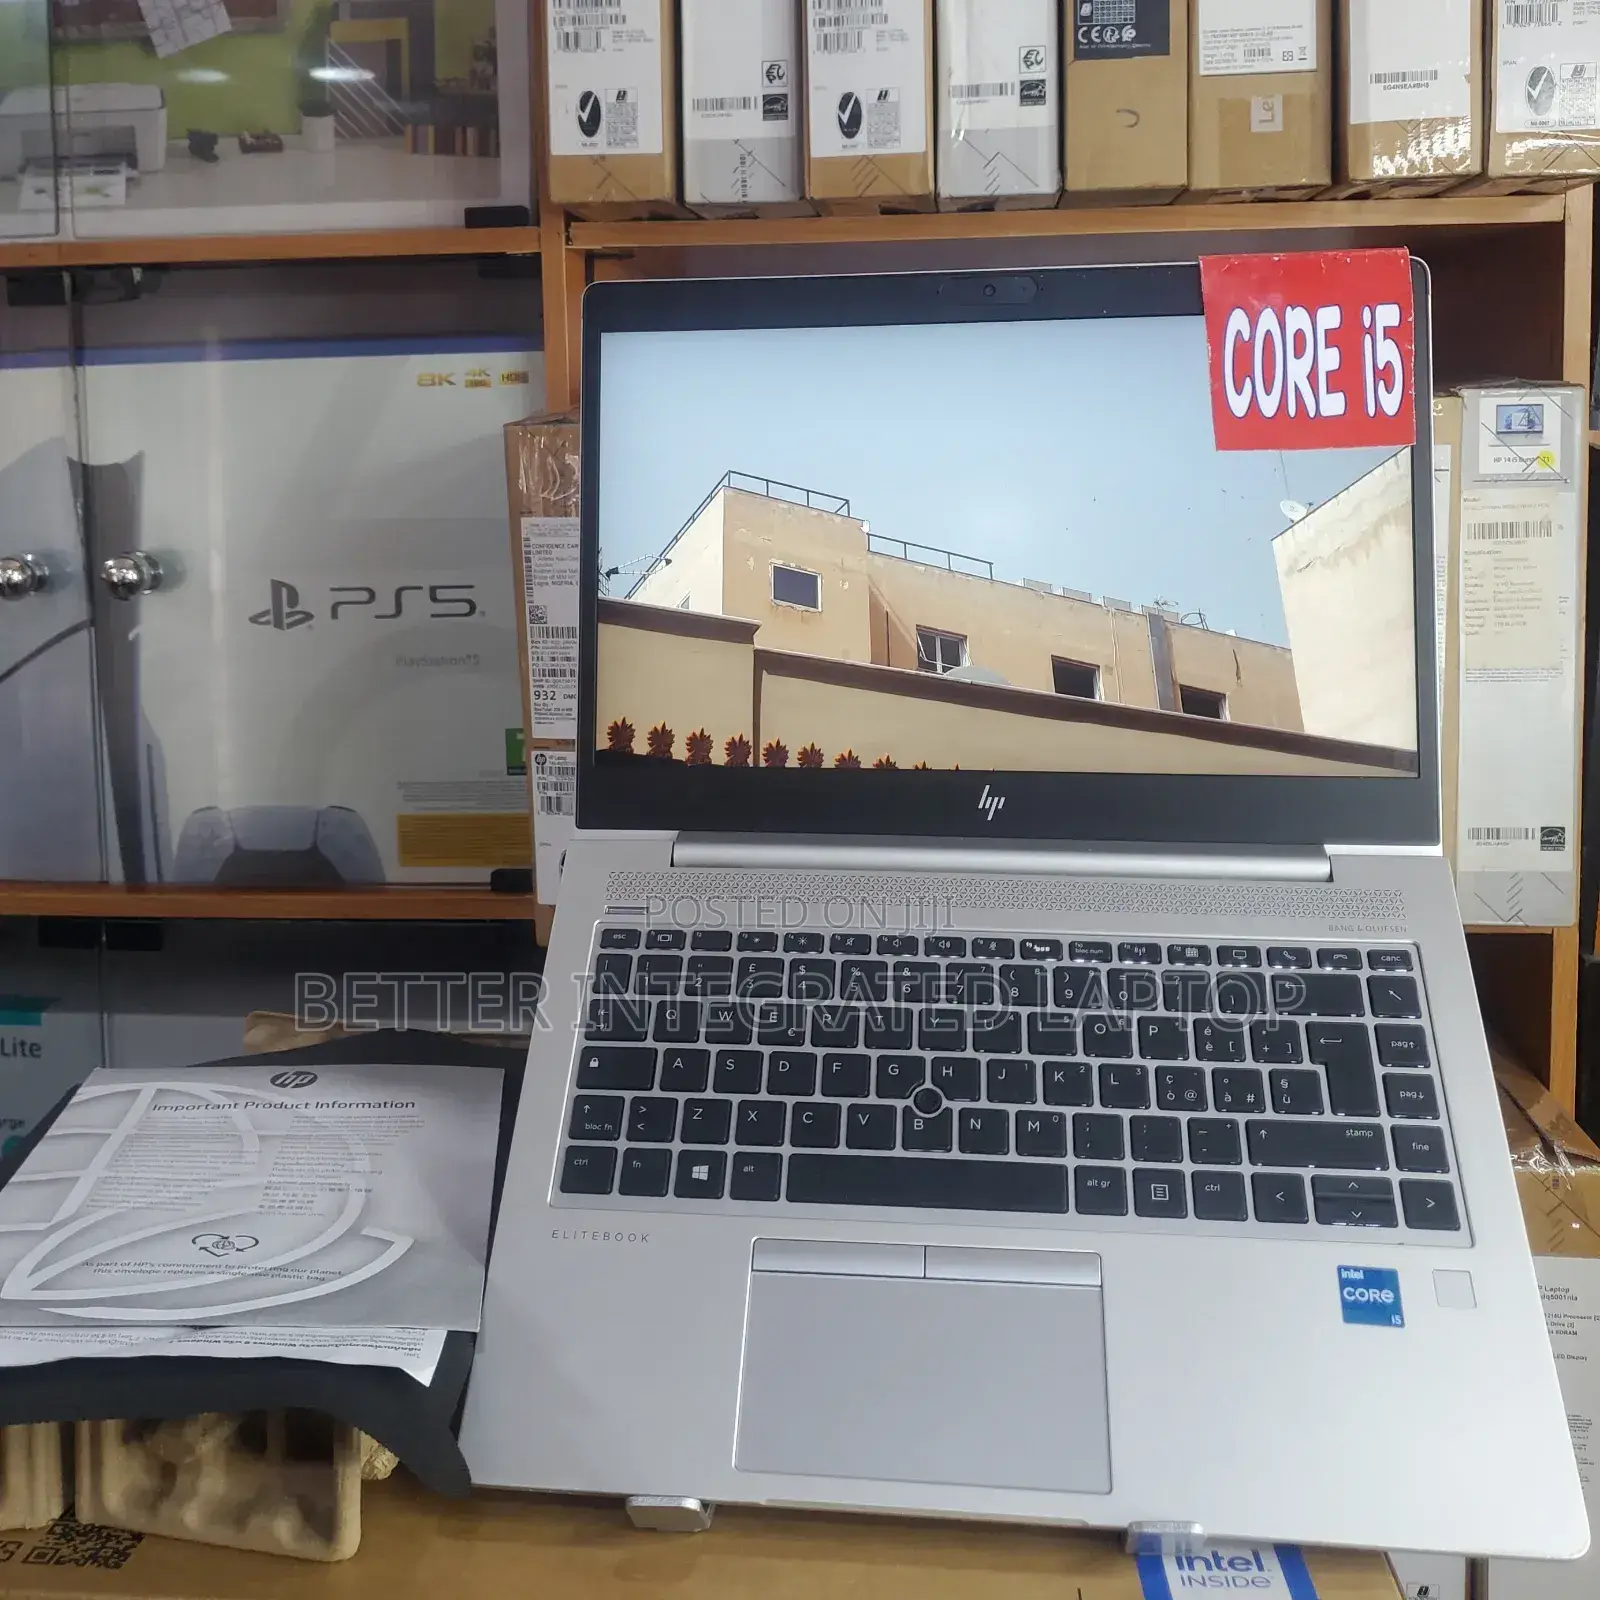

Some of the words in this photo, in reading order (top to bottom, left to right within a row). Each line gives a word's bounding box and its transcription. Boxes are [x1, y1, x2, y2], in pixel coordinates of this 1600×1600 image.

[1223, 304, 1347, 419] CORE
[1362, 303, 1404, 419] i5
[329, 585, 477, 620] PS5
[534, 690, 556, 701] 932
[1381, 954, 1402, 962] canc
[695, 978, 702, 987] 2
[746, 979, 754, 989] 3
[798, 981, 806, 990] 4
[850, 982, 858, 992] 5
[902, 984, 911, 993] 6
[956, 985, 964, 995] 7
[1010, 987, 1019, 997] 8
[1064, 989, 1074, 999] 9
[666, 1009, 677, 1020] Q
[718, 1010, 734, 1021] W
[769, 1012, 778, 1023] E
[822, 1013, 832, 1024] R
[875, 1015, 884, 1026] T
[930, 1017, 940, 1028] Y
[984, 1019, 994, 1030] U
[1149, 1025, 1159, 1036] P
[0, 1037, 42, 1058] Lite
[672, 1057, 684, 1069] A
[725, 1058, 735, 1070] S
[779, 1060, 790, 1072] D
[832, 1062, 842, 1073] F
[888, 1064, 900, 1076] G
[942, 1065, 953, 1077] H
[997, 1068, 1006, 1080] J
[1054, 1070, 1065, 1083] K
[1110, 1073, 1120, 1085] L
[152, 1102, 238, 1113] Important
[244, 1101, 310, 1111] Product
[315, 1100, 416, 1111] Information
[692, 1108, 703, 1120] Z
[747, 1110, 758, 1122] X
[802, 1111, 814, 1124] C
[858, 1113, 870, 1125] V
[585, 1122, 601, 1131] bloc
[604, 1122, 613, 1131] fn
[913, 1118, 924, 1130] B
[970, 1118, 981, 1130] N
[1027, 1120, 1040, 1132] M
[1345, 1128, 1374, 1140] stamp
[1411, 1142, 1430, 1151] fine
[574, 1158, 589, 1166] ctrl
[632, 1160, 642, 1168] fn
[743, 1164, 755, 1173] alt
[1086, 1178, 1099, 1187] alt
[1100, 1180, 1111, 1189] gr
[1205, 1183, 1221, 1192] ctrl
[551, 1229, 650, 1243] ELITEBOOK
[237, 1265, 289, 1273] protecting
[1341, 1269, 1364, 1280] intel
[1545, 1285, 1570, 1294] Laptop
